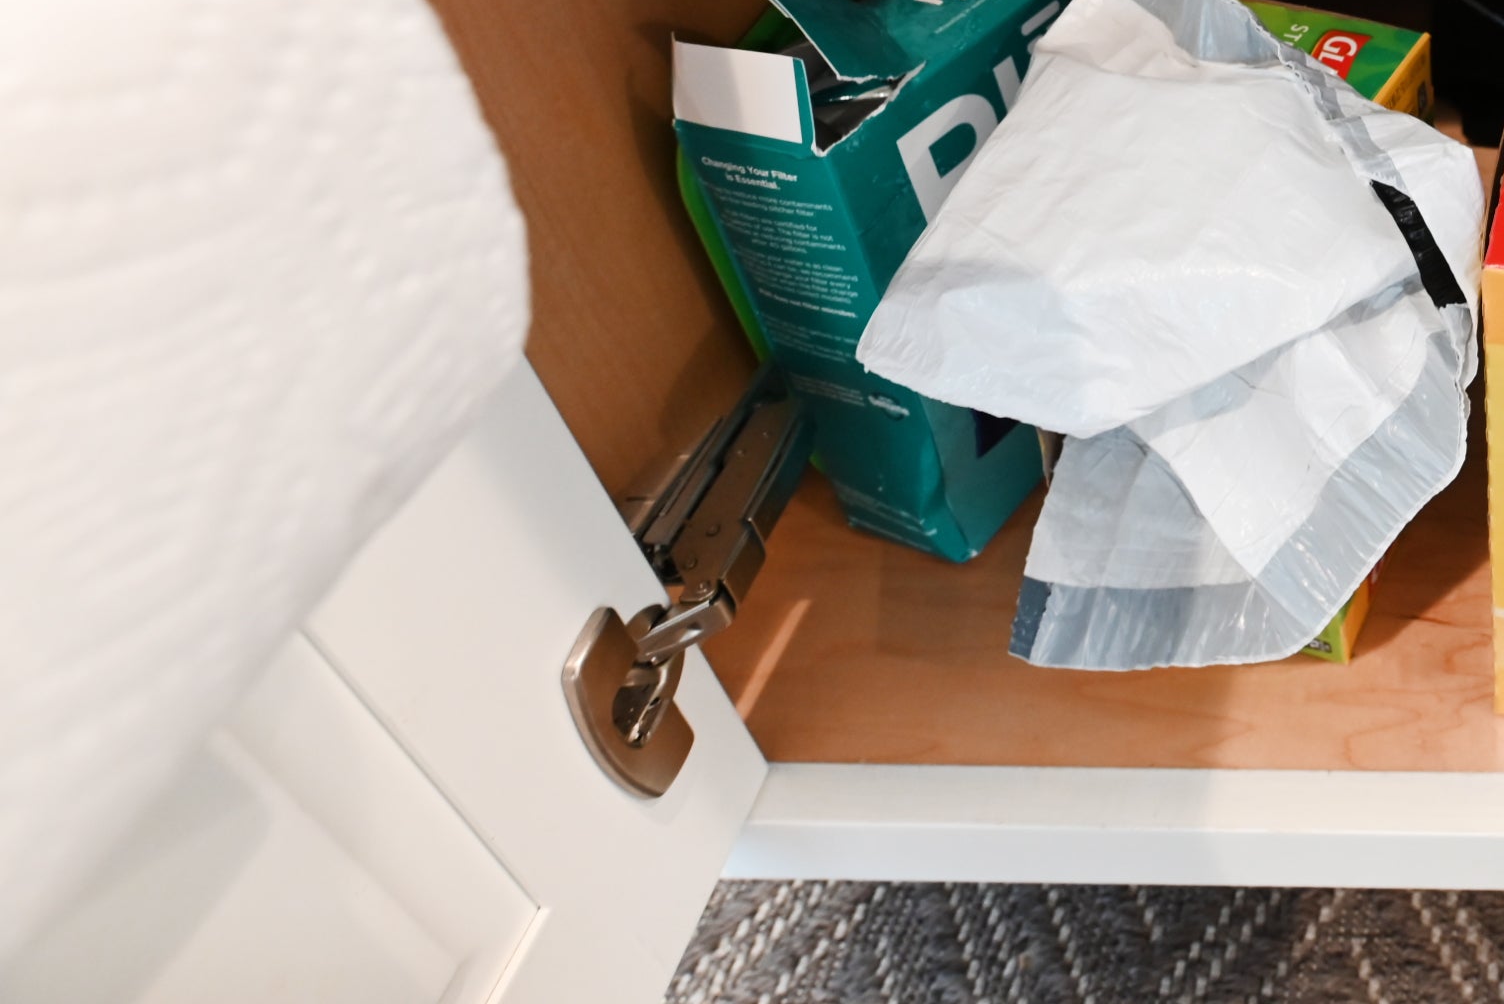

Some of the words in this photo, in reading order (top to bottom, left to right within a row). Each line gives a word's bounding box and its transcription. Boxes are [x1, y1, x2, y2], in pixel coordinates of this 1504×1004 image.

[1283, 23, 1309, 47] ST
[1316, 34, 1359, 76] GL
[701, 156, 747, 175] Changing
[747, 165, 769, 178] Your
[770, 169, 798, 183] Filter
